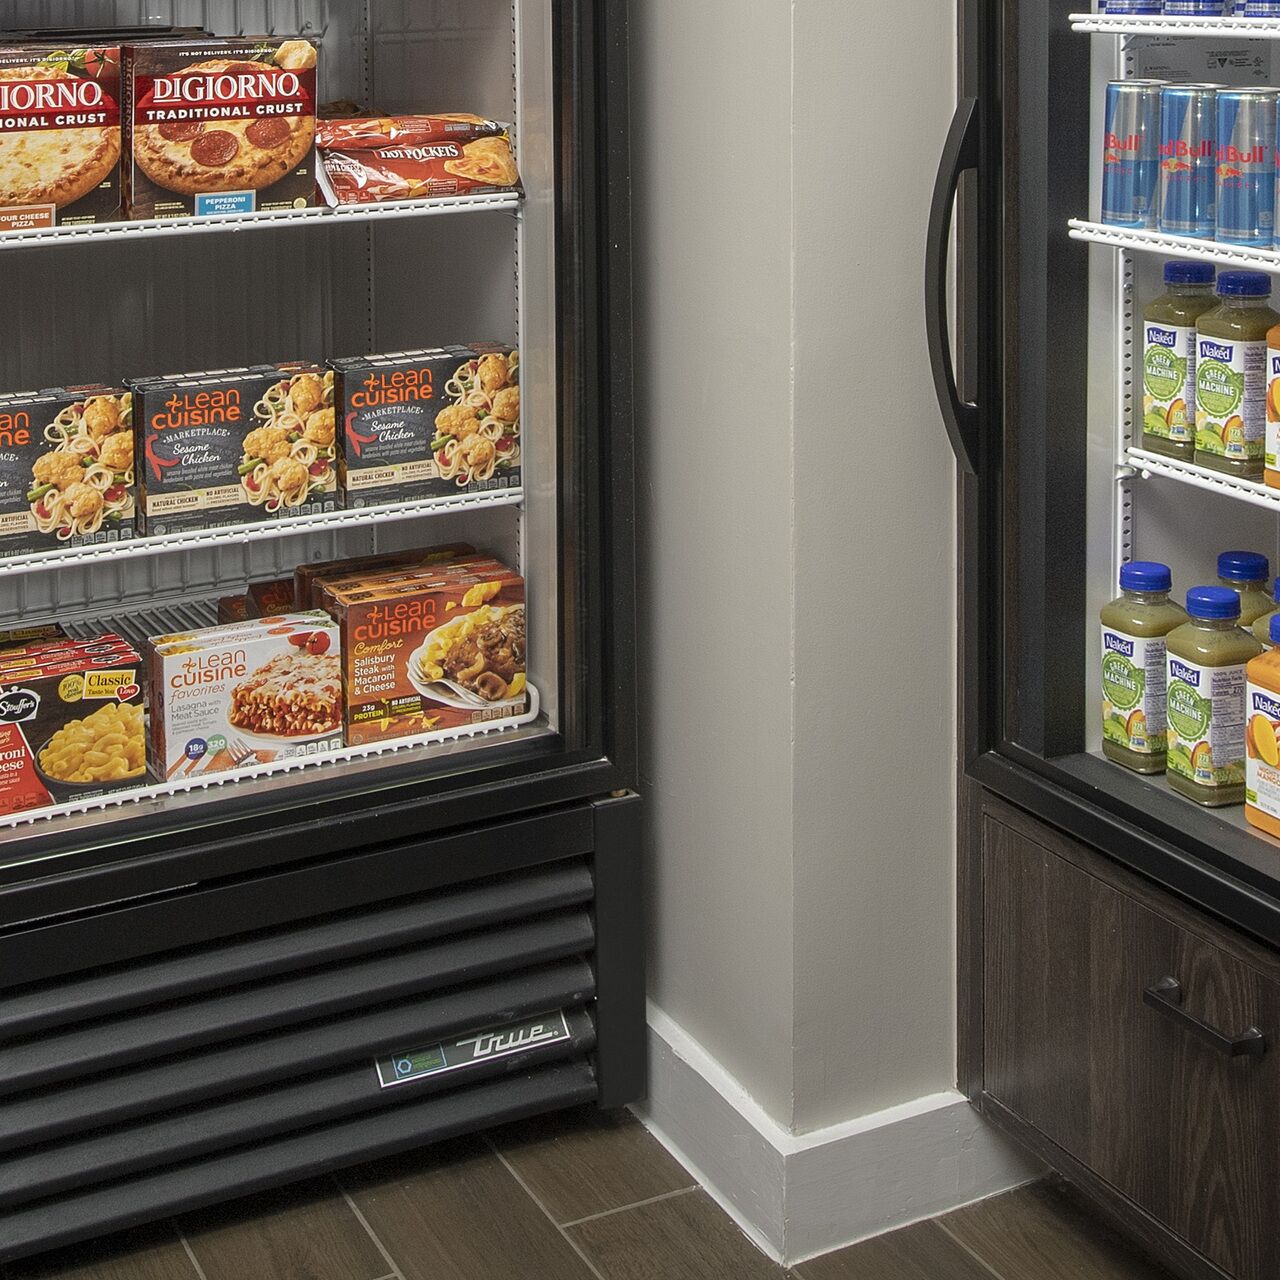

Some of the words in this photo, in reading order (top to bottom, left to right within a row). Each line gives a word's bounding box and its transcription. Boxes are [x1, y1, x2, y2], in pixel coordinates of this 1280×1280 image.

[154, 73, 300, 103] DIGIORNO
[56, 113, 107, 125] CRUST
[147, 106, 250, 120] TRADITIONAL
[256, 103, 303, 115] CRUST
[403, 145, 459, 160] POCKETS
[1175, 140, 1211, 157] Bull
[205, 197, 246, 205] PEPPERONI
[214, 202, 236, 210] PIZZA
[11, 219, 35, 227] PIZZA
[20, 212, 50, 222] CHEESE
[1148, 331, 1176, 346] Naked
[1202, 344, 1232, 361] Naked
[1152, 355, 1172, 367] GREEN
[1145, 365, 1178, 381] MACHINE
[1199, 381, 1234, 397] MACHINE
[364, 406, 421, 421] MARKETPLACE
[371, 420, 405, 432] Sesame
[165, 429, 228, 444] MARKETPLACE
[378, 431, 416, 442] Chicken
[172, 443, 210, 455] Sesame
[181, 454, 221, 466] Chicken
[354, 637, 403, 655] Comfort
[1106, 635, 1131, 655] Naked
[354, 652, 395, 668] Salisbury
[354, 665, 379, 676] Steak
[88, 673, 131, 687] Classic
[354, 671, 395, 687] Macaroni
[1104, 672, 1136, 691] MACHINE
[169, 684, 225, 704] favorites
[363, 681, 395, 693] Cheese
[170, 701, 206, 714] Lasagna
[354, 710, 384, 720] PROTEIN
[1170, 700, 1202, 720] MACHINE
[170, 710, 192, 722] Meat
[456, 1024, 553, 1057] True
